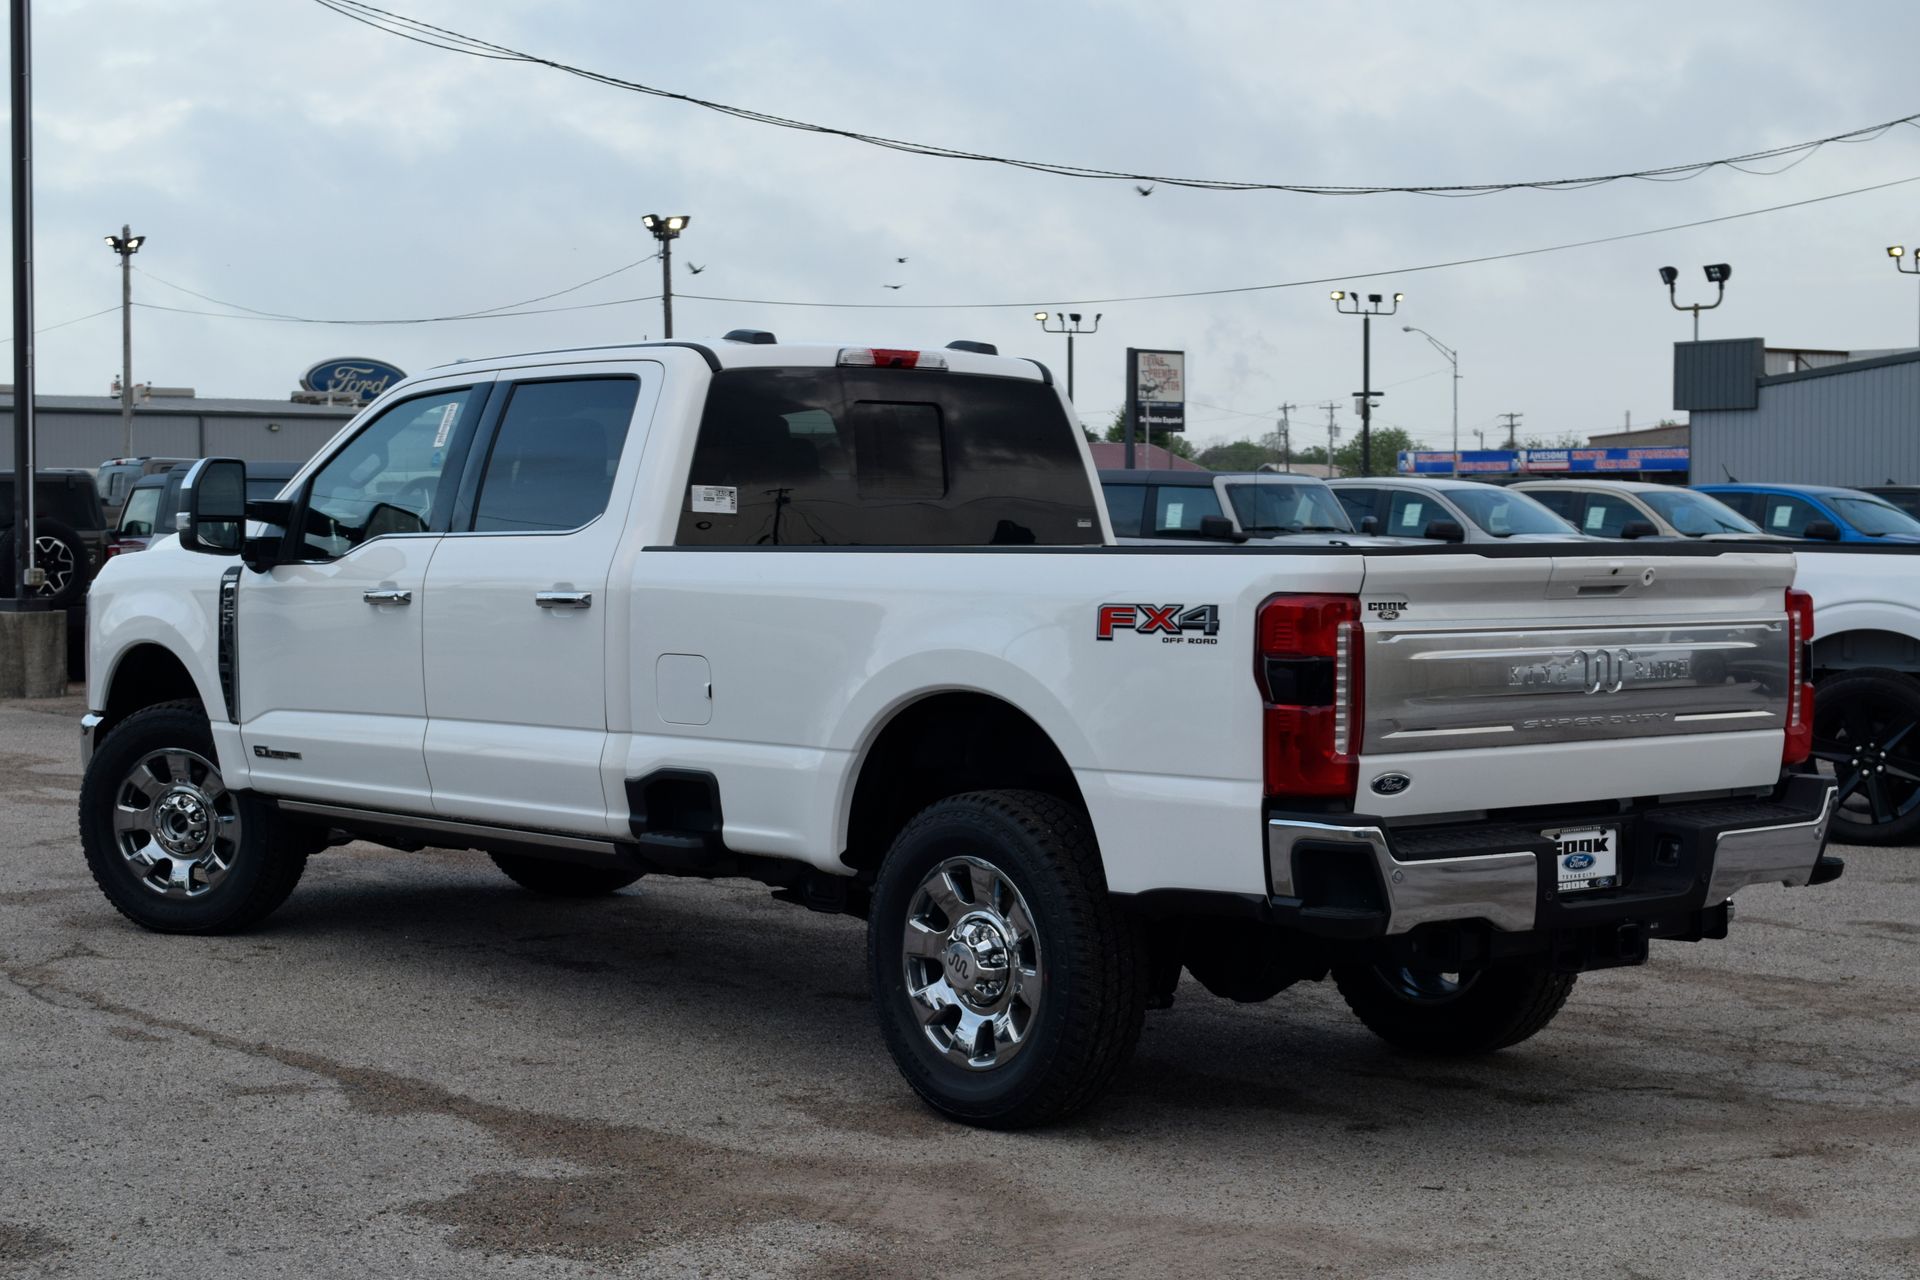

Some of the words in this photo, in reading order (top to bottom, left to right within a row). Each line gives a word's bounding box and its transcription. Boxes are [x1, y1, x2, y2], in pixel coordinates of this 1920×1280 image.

[333, 366, 389, 394] Ford
[1528, 451, 1569, 460] AWESOME
[1368, 602, 1408, 611] COOK
[1096, 603, 1220, 641] FX4
[1188, 637, 1218, 645] ROAD
[1508, 664, 1568, 686] KING
[1634, 657, 1690, 679] RANCH
[1523, 716, 1604, 729] SUPER
[1609, 712, 1668, 724] DUTY
[1569, 855, 1589, 868] Ford
